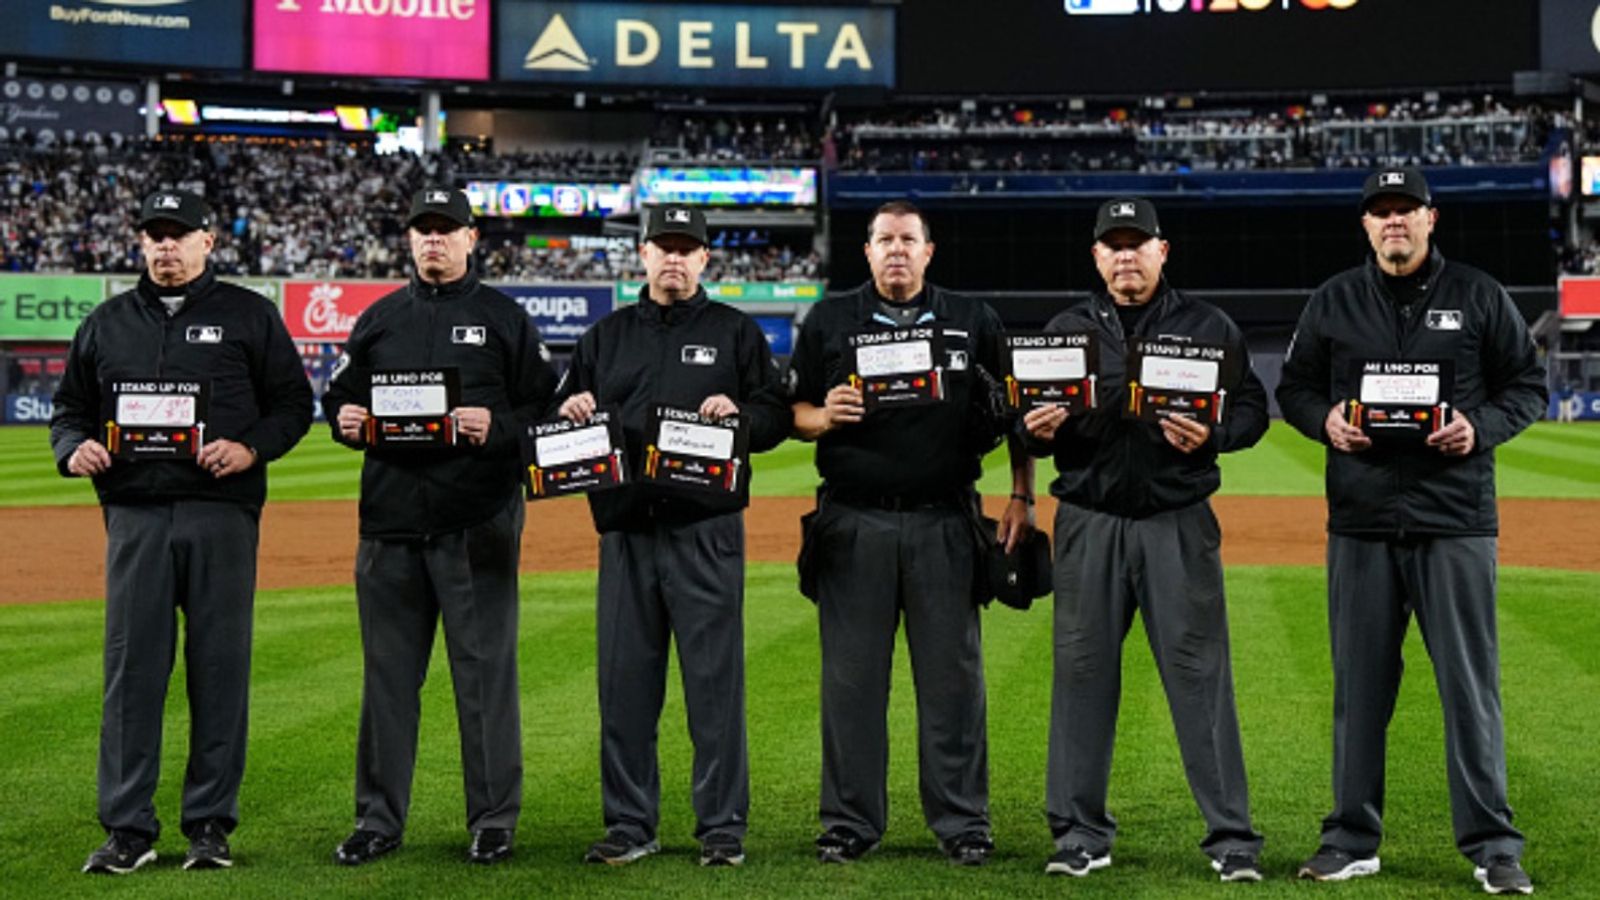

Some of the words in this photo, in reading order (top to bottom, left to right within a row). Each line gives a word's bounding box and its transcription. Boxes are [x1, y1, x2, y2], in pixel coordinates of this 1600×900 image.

[50, 5, 189, 29] BuyFordNow.com
[616, 19, 872, 70] DELTA
[16, 293, 95, 321] Eats
[515, 296, 588, 322] oupa
[848, 336, 855, 346] I
[857, 332, 891, 345] STAND
[894, 330, 909, 340] UP
[911, 328, 934, 339] FOR
[1013, 336, 1046, 347] STAND
[1048, 337, 1063, 347] UP
[1066, 335, 1089, 347] FOR
[1145, 343, 1181, 356] STAND
[1183, 347, 1200, 357] UP
[1201, 347, 1224, 360] FOR
[1363, 362, 1381, 373] ME
[1384, 363, 1412, 373] UNO
[1414, 363, 1440, 374] POR
[371, 374, 388, 384] ME
[391, 373, 419, 384] UNO
[420, 371, 444, 383] POR
[112, 382, 118, 393] I
[120, 382, 158, 393] STAND
[159, 382, 176, 393] UP
[178, 382, 201, 394] FOR
